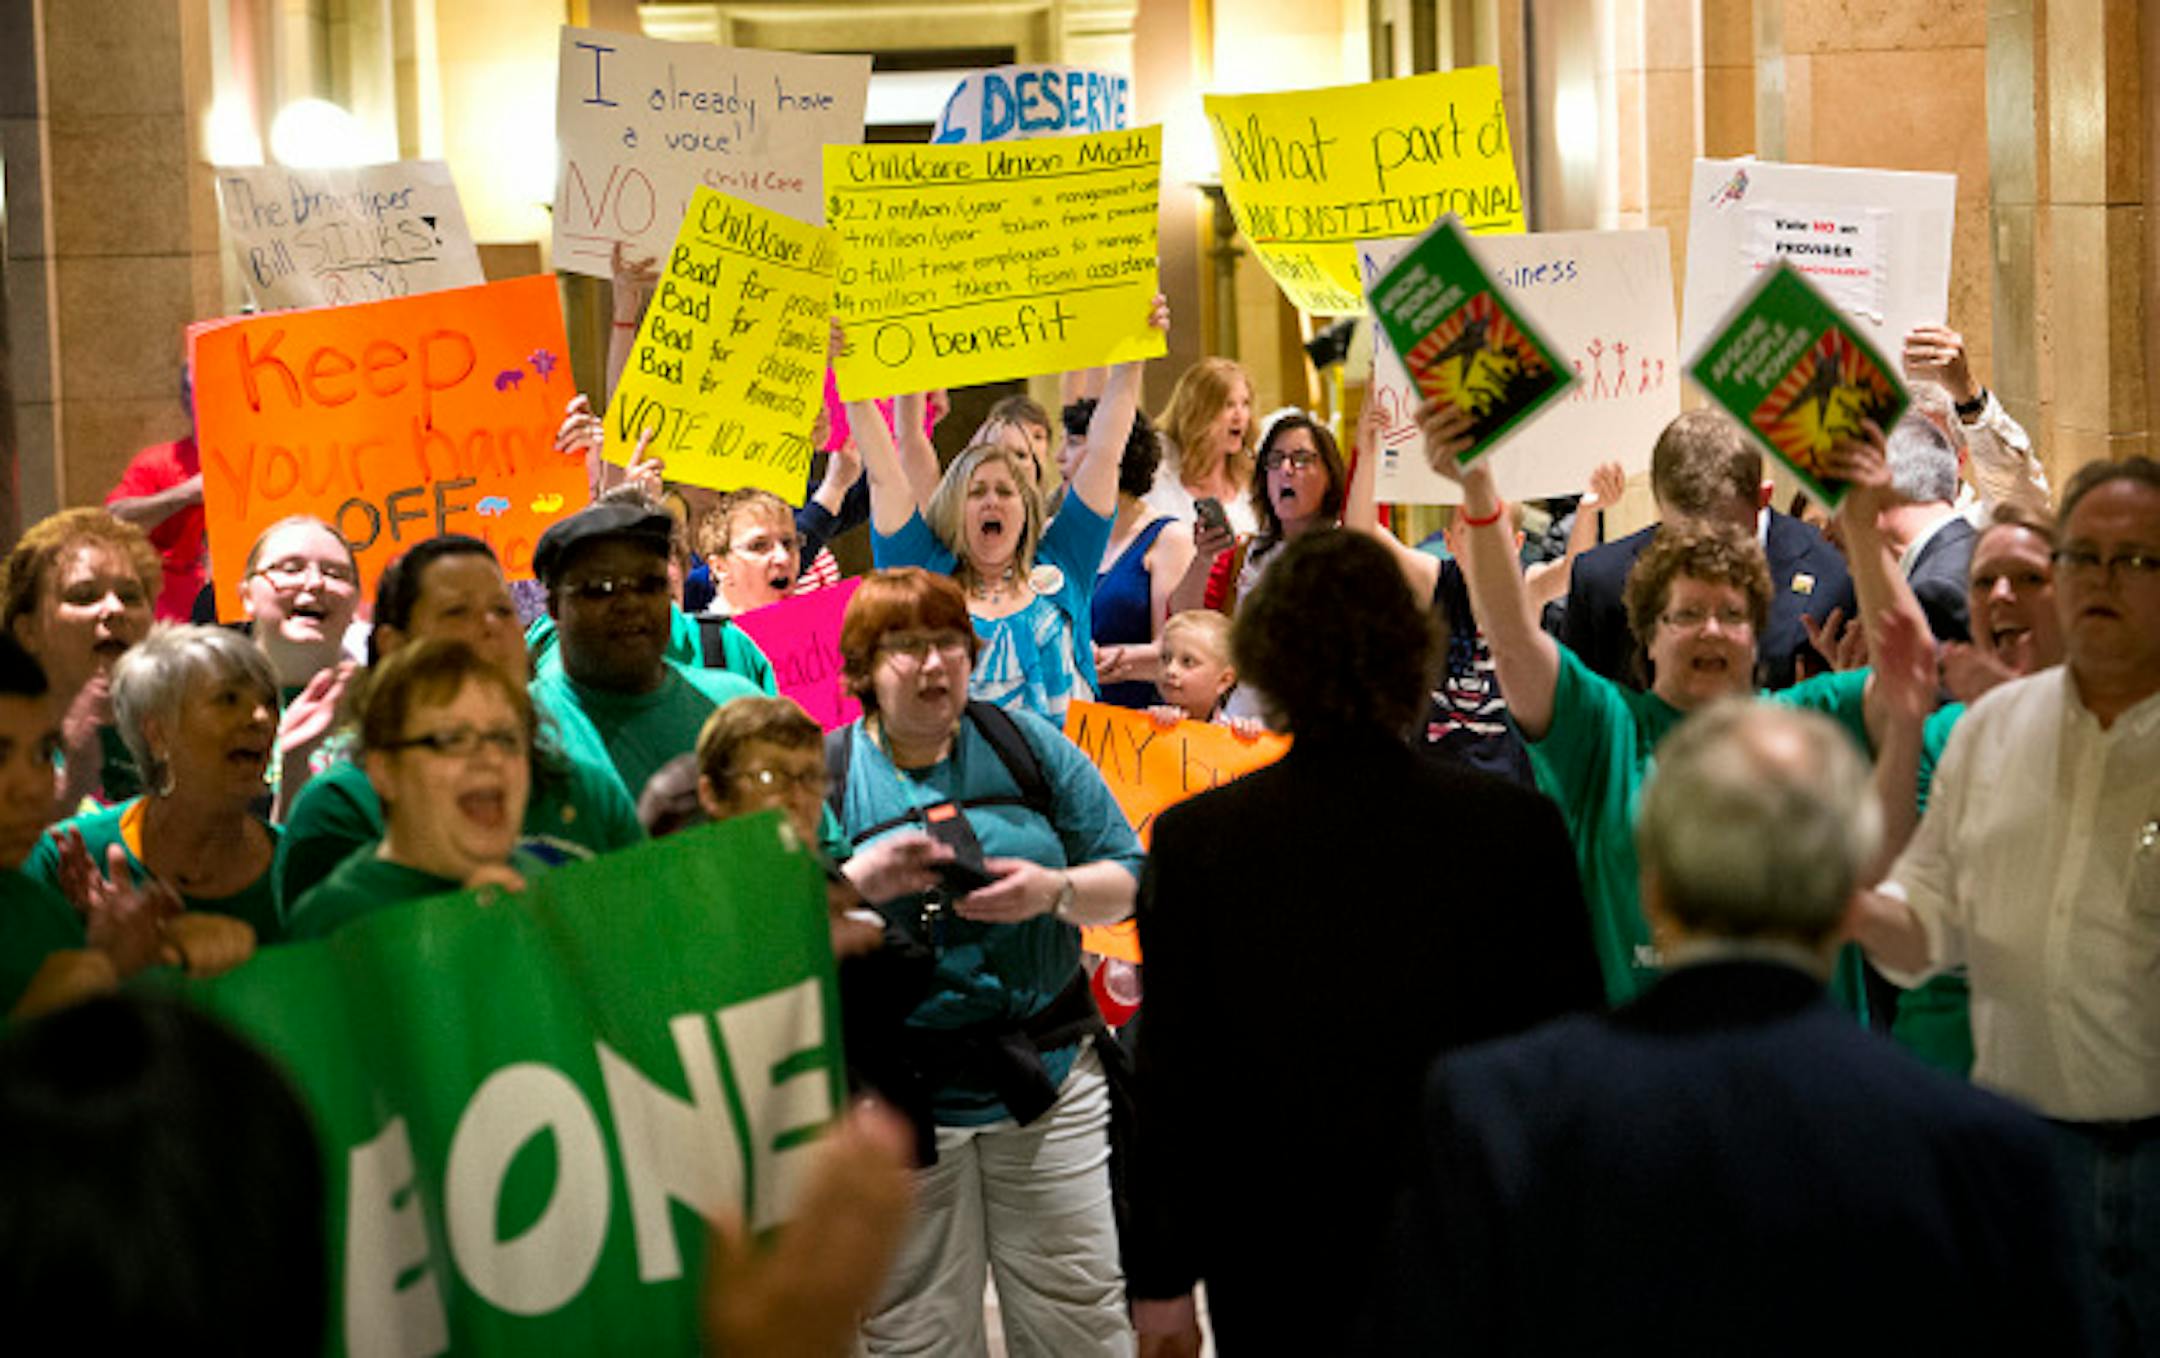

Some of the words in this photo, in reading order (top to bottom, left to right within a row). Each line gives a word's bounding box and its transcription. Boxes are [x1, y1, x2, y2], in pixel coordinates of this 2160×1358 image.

[576, 41, 620, 107] I
[649, 61, 755, 133] already
[774, 73, 834, 112] have
[980, 70, 1128, 143] DESERVE
[622, 126, 639, 149] a
[847, 151, 974, 184] Childcare
[985, 150, 1064, 179] Union
[1076, 134, 1150, 168] Math
[1214, 111, 1338, 184] What
[1371, 101, 1465, 194] part
[224, 177, 288, 231] The
[563, 160, 657, 236] NO
[698, 195, 804, 261] Childcare
[250, 236, 297, 289] Bill
[671, 244, 721, 288] Bad
[660, 281, 711, 324] Bad
[928, 299, 1076, 359] benefit
[639, 346, 683, 385] Bad
[650, 315, 693, 354] Bad
[237, 328, 476, 432] Keep
[617, 393, 712, 452] VOTE
[708, 420, 746, 458] NO
[210, 434, 390, 522] your
[335, 476, 478, 553] OFF
